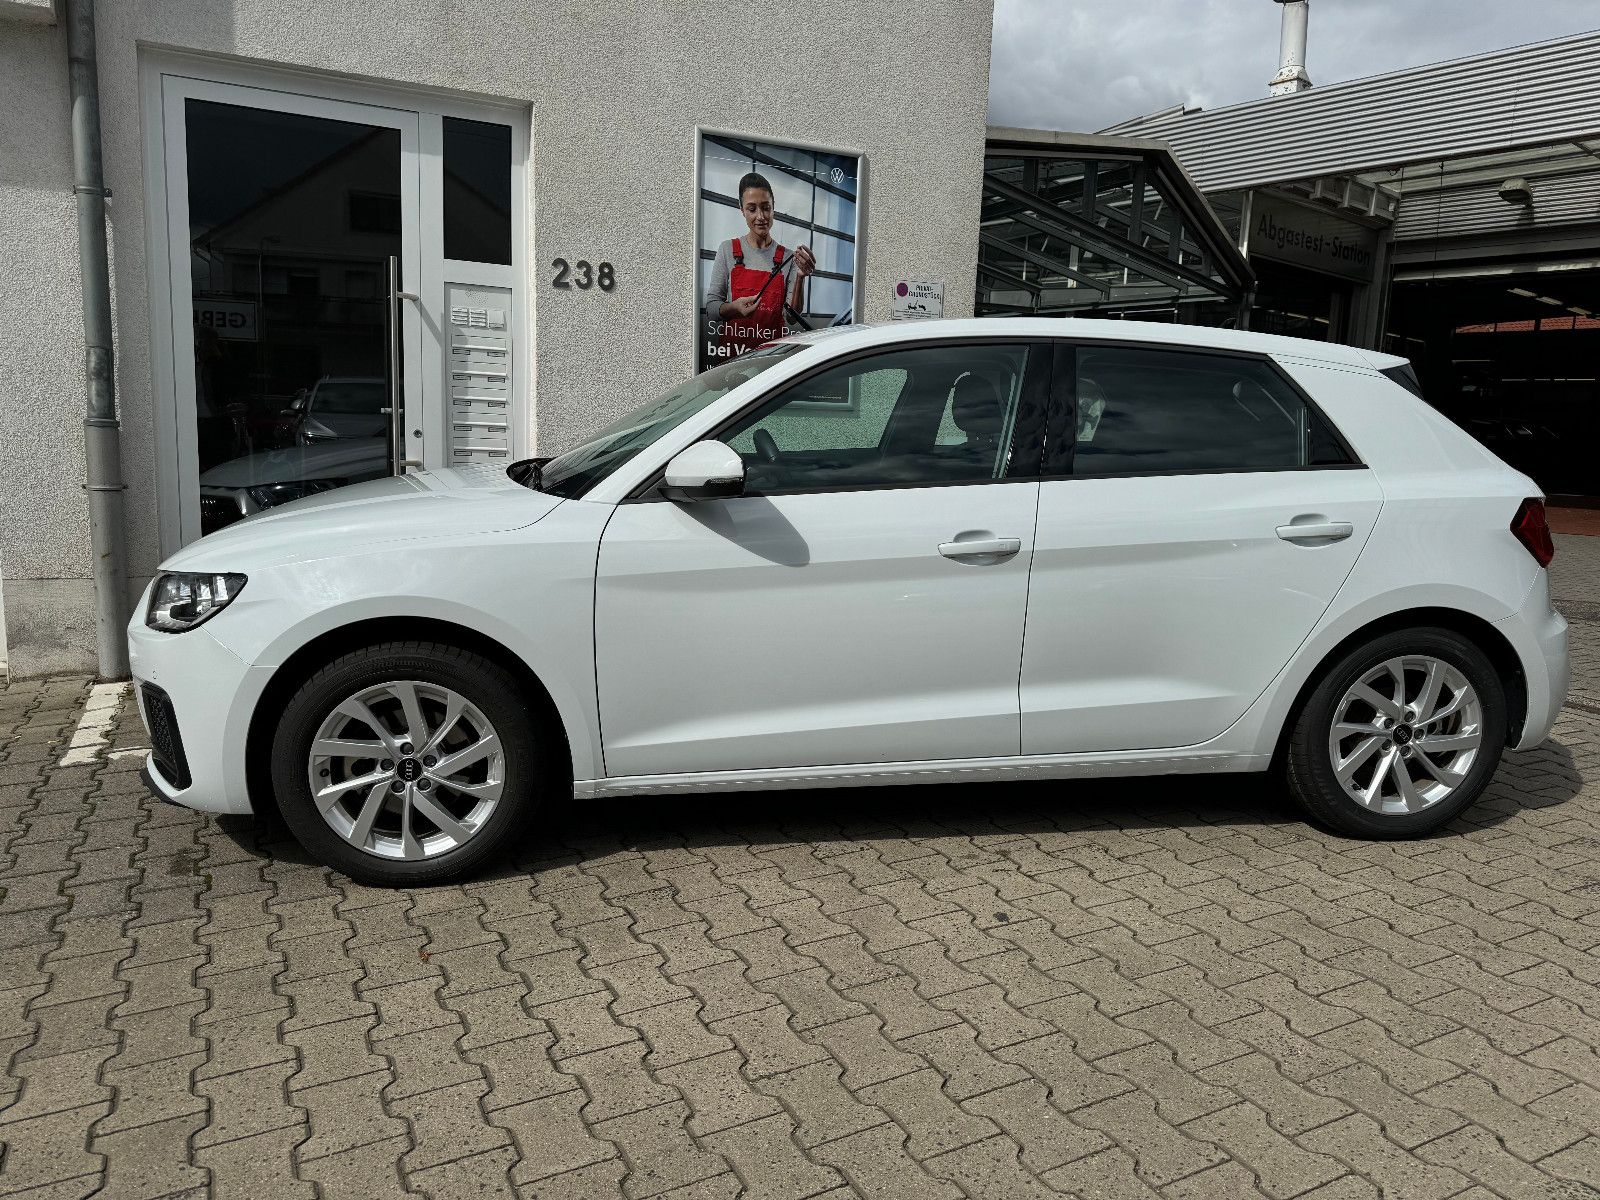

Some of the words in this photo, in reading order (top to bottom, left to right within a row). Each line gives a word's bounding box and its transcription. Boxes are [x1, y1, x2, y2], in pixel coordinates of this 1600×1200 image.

[1257, 214, 1371, 265] Abgastest-Station
[551, 258, 615, 292] 238
[707, 320, 777, 340] Schlanker
[707, 341, 731, 357] bei
[734, 343, 752, 356] V
